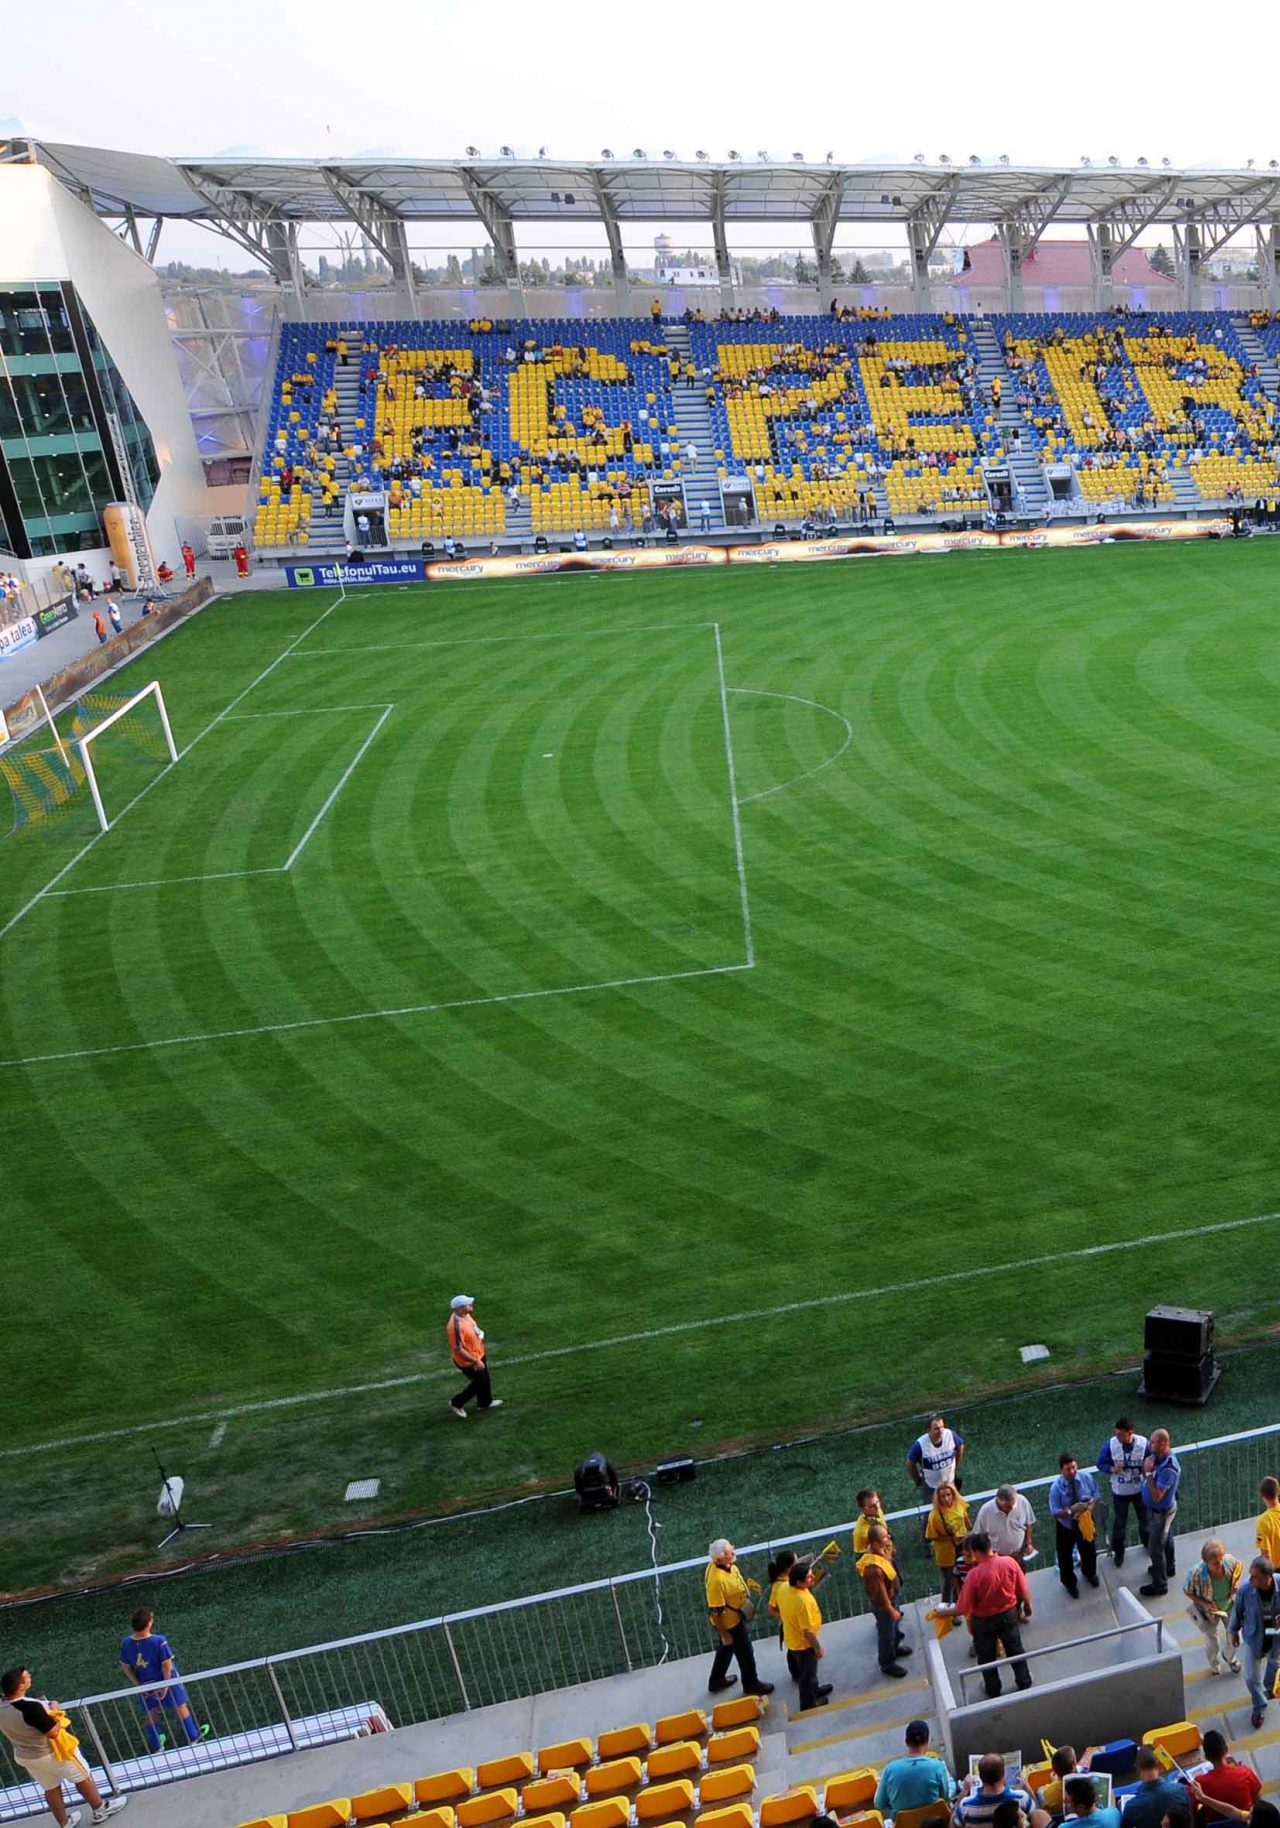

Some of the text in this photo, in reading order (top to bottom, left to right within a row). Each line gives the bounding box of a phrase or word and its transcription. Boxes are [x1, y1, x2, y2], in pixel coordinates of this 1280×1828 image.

[944, 535, 984, 546] mercury
[1009, 532, 1048, 542] mercury
[738, 548, 780, 558] mercury
[808, 543, 849, 553] mercury
[591, 554, 636, 564] mercury
[665, 550, 709, 561] mercury
[438, 563, 484, 574] mercury
[515, 557, 560, 571] mercury
[136, 1652, 149, 1668] 4
